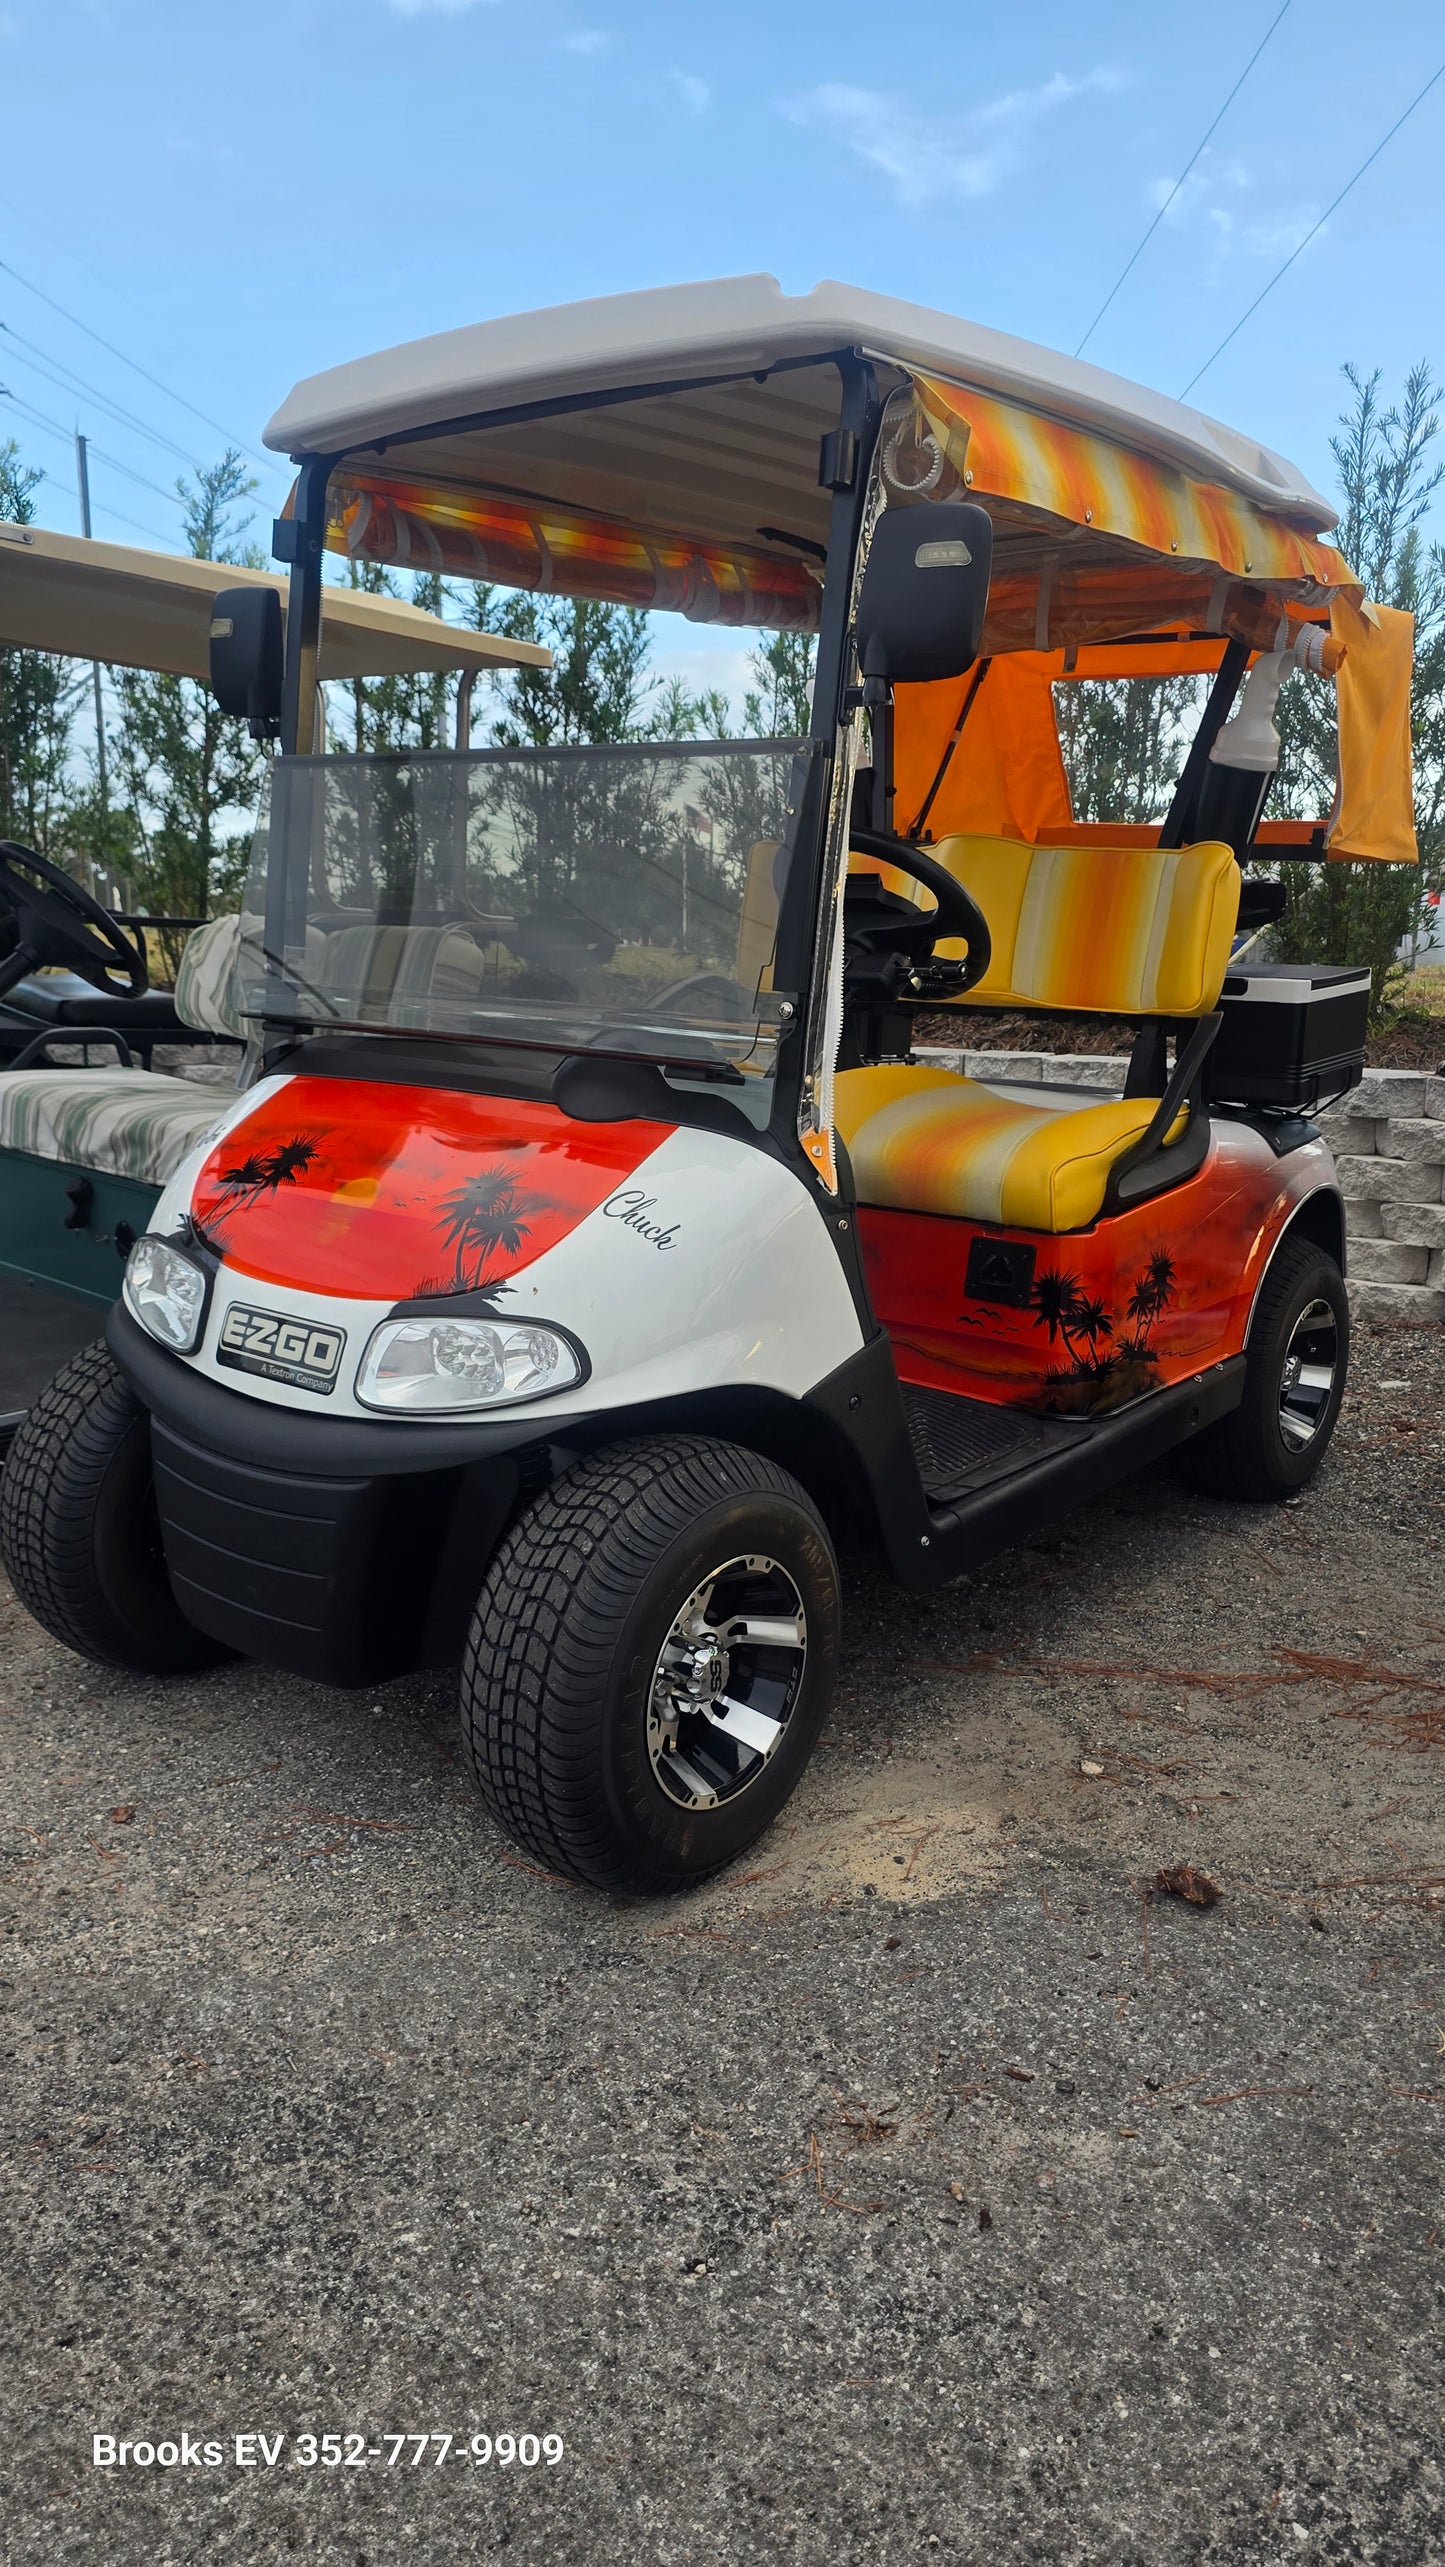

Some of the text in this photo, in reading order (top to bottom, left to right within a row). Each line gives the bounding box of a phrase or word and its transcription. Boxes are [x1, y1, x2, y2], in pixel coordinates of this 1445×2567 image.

[603, 1190, 681, 1251] Chuck
[260, 1363, 334, 1393] A Textron Company
[710, 1659, 722, 1693] SS
